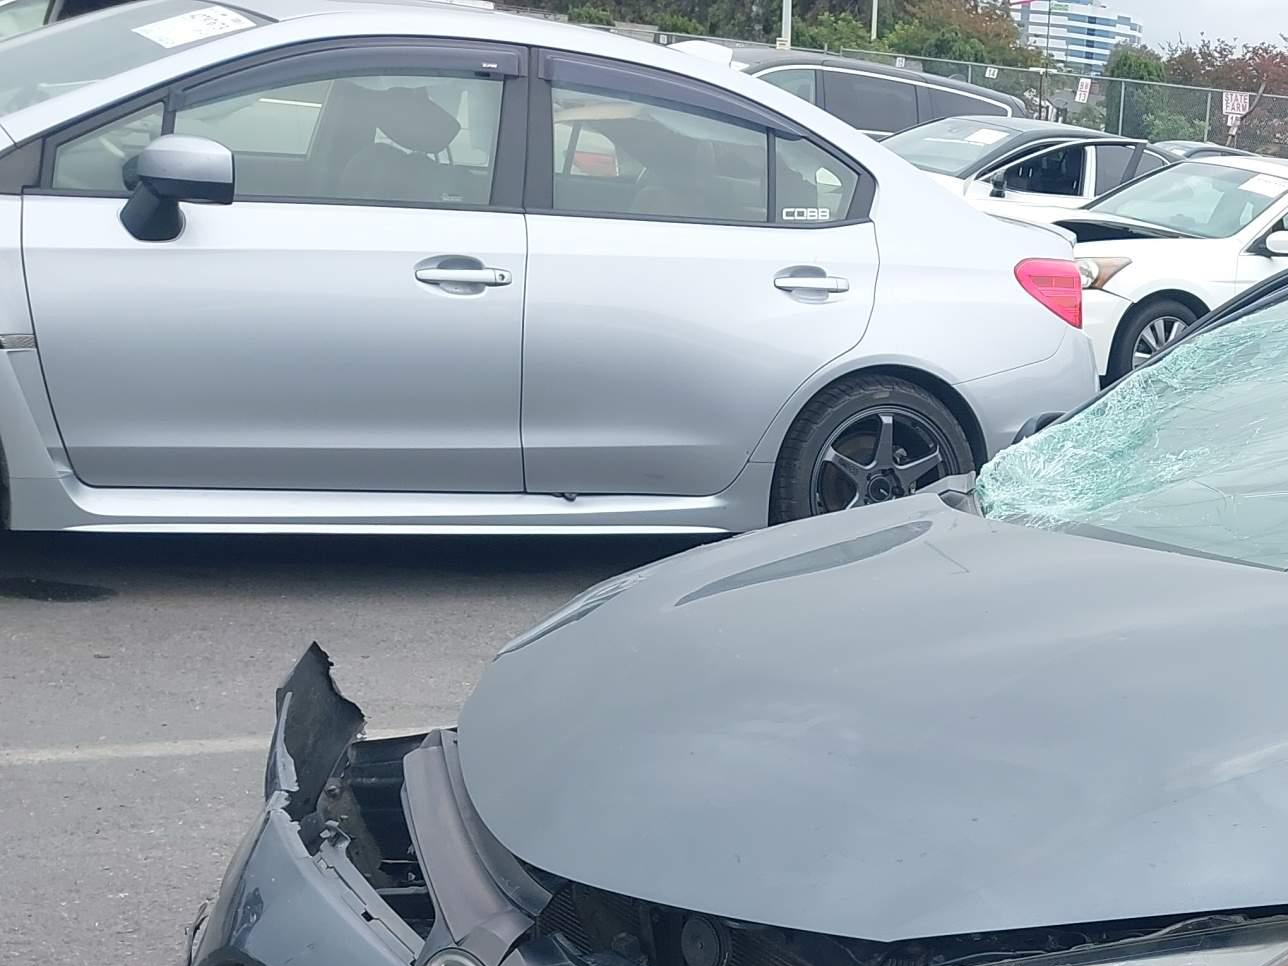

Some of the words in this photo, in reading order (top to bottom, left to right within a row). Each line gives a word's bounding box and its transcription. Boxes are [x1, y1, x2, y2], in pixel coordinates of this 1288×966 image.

[1225, 93, 1249, 103] STATE
[1226, 102, 1247, 112] FARM
[782, 208, 830, 220] COBB
